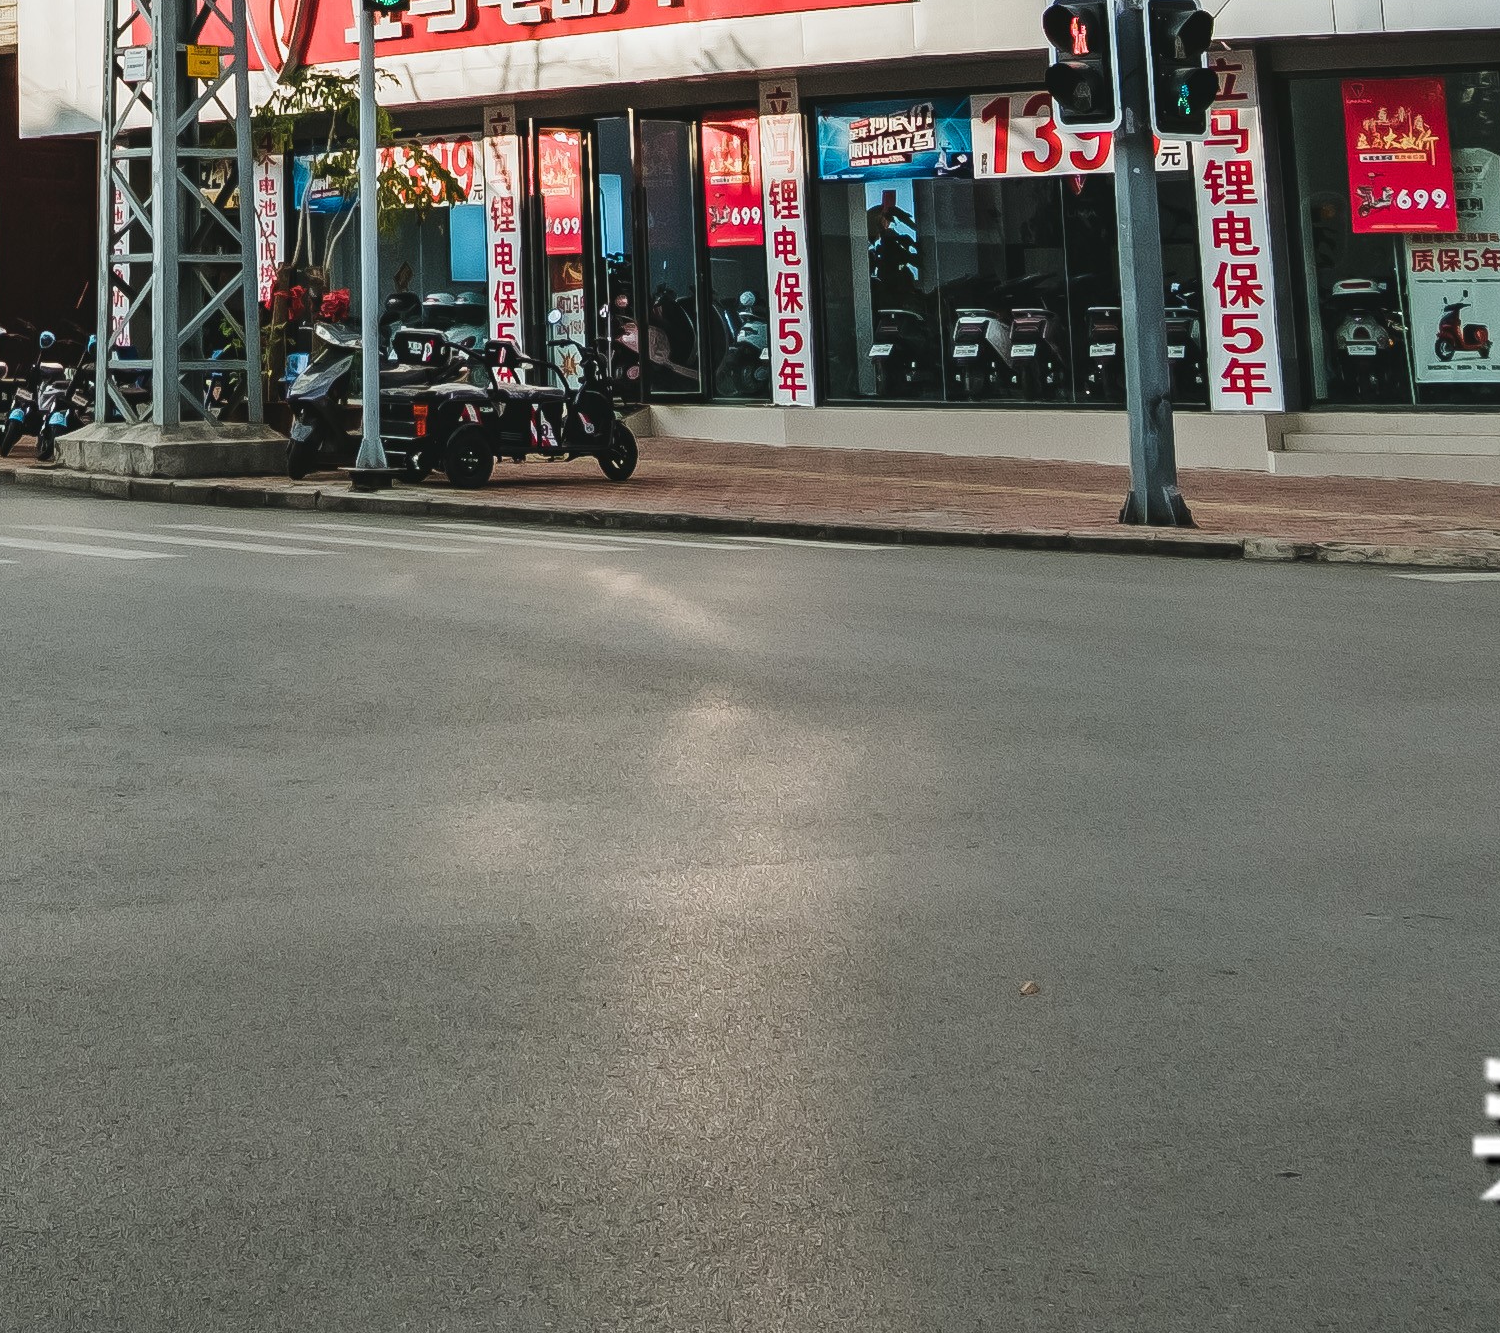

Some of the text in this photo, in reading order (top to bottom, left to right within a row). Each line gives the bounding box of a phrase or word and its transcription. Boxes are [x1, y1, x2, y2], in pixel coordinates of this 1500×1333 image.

[1396, 188, 1448, 211] 699
[553, 217, 580, 235] 699
[731, 206, 760, 226] 699
[1203, 58, 1272, 405] 立马锂电保5年
[764, 86, 808, 401] 立马锂电保5年
